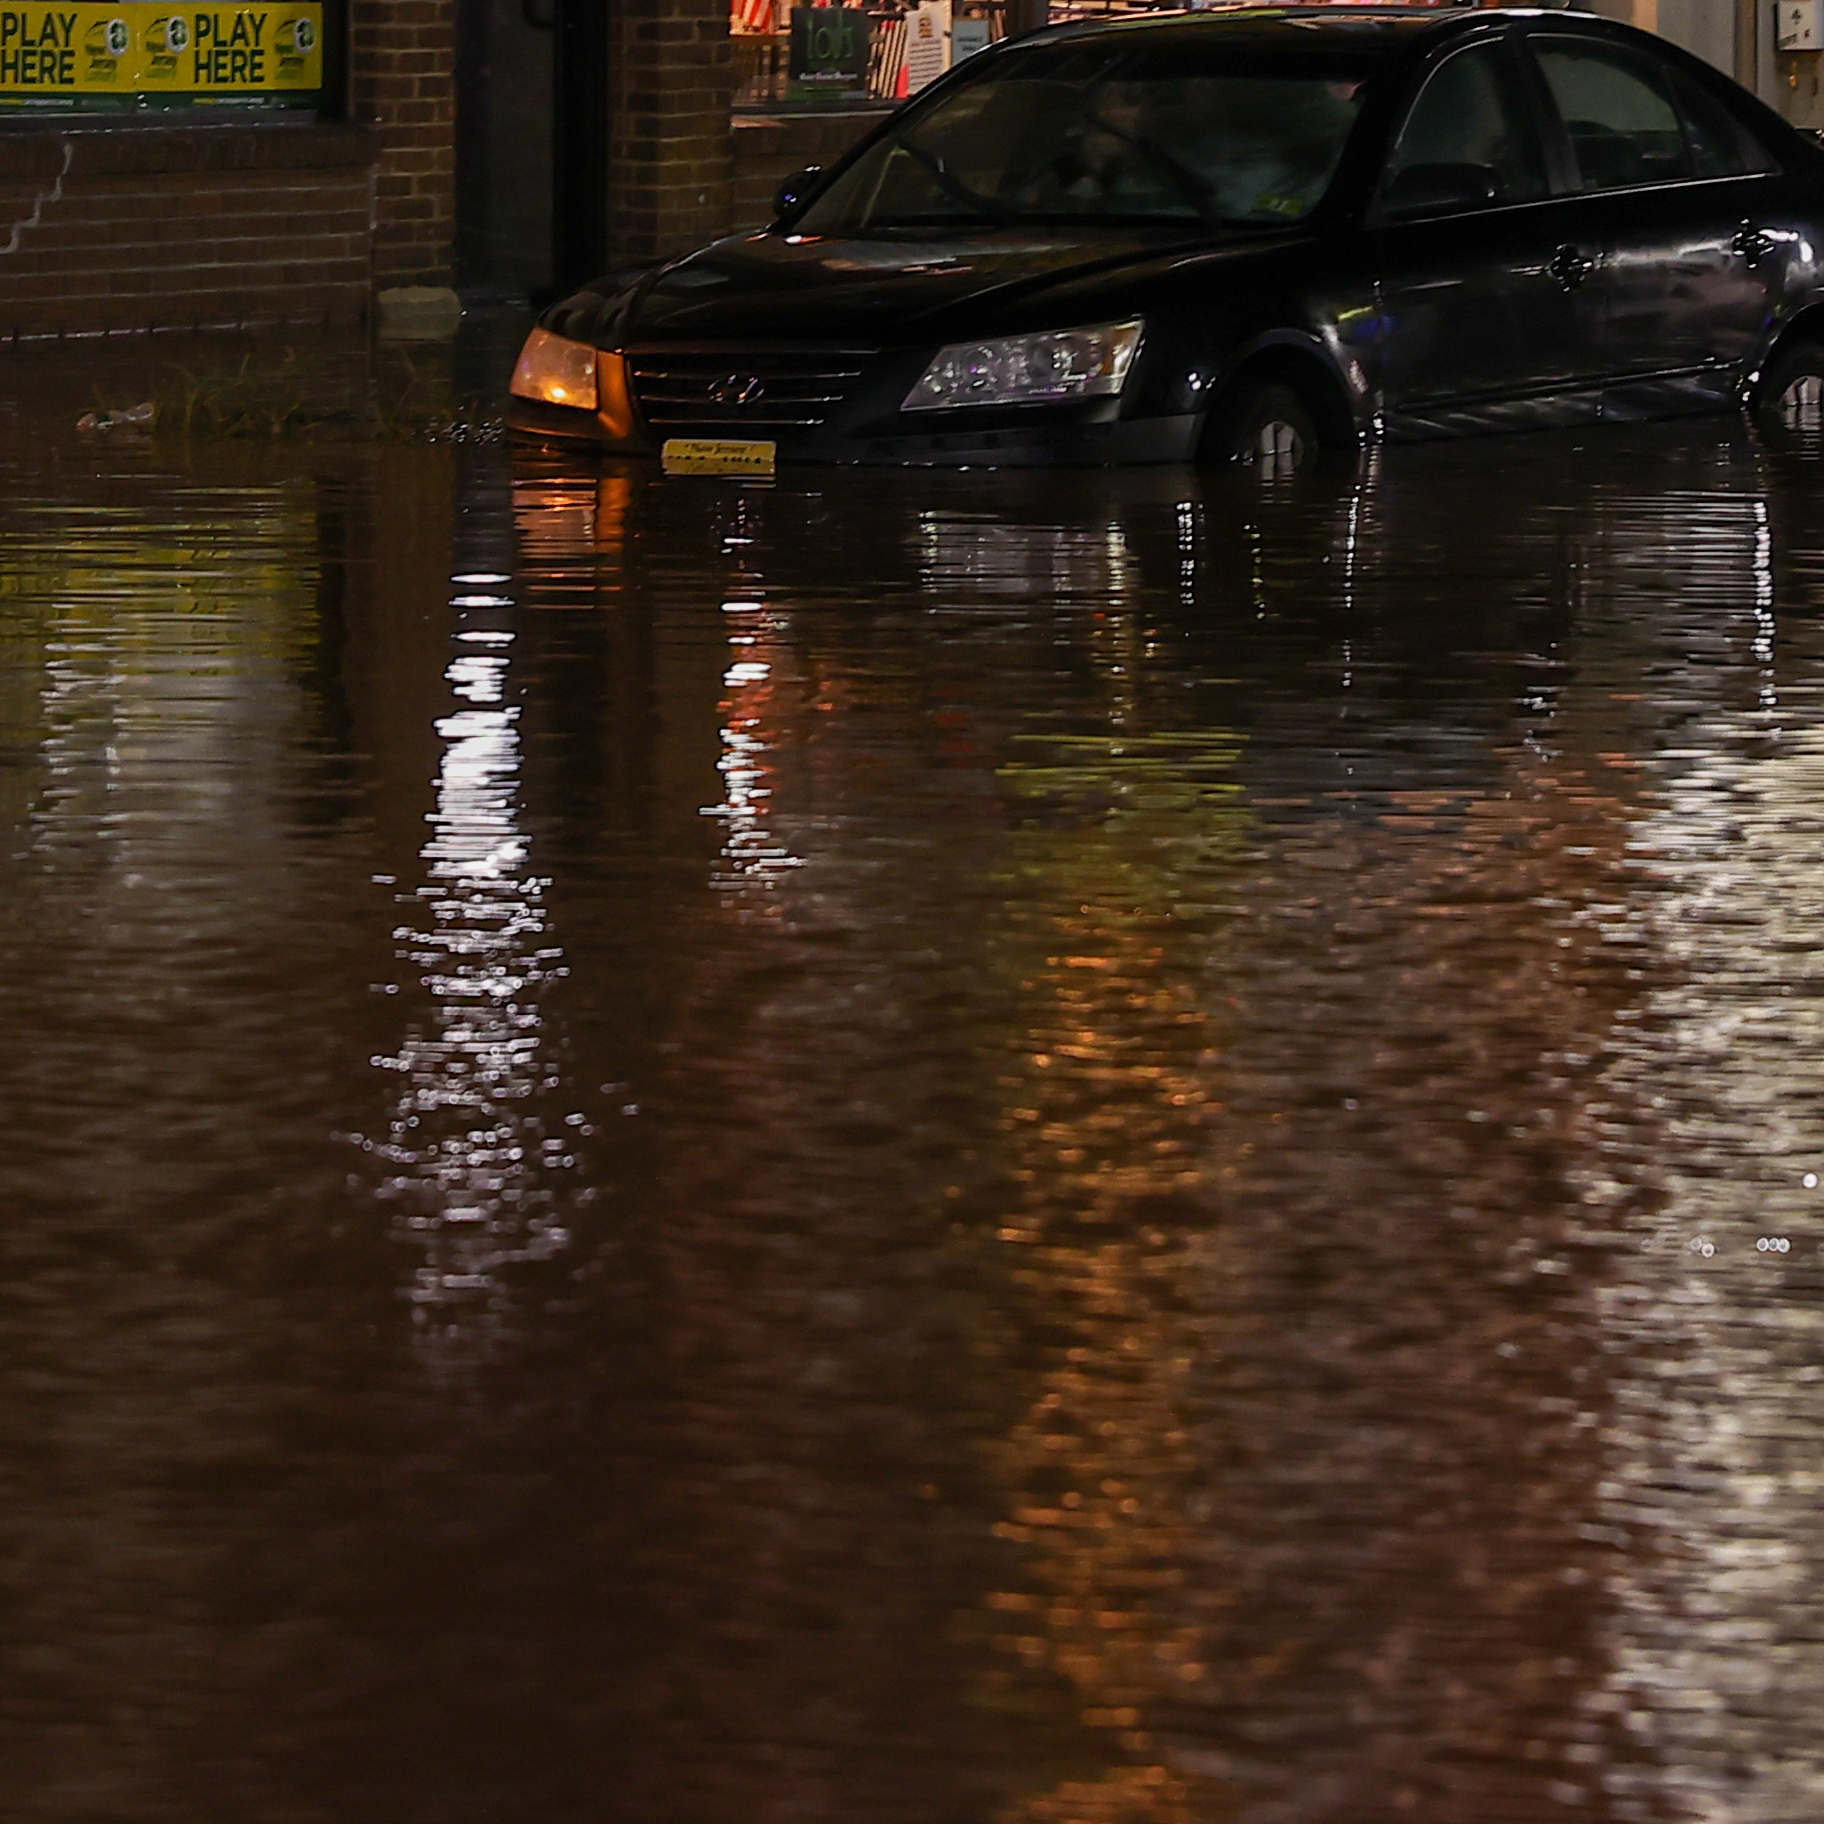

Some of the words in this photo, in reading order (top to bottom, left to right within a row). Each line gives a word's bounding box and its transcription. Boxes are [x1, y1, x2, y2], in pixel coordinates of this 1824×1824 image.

[0, 12, 78, 48] PLAY
[195, 12, 268, 48] PLAY
[0, 49, 76, 85] HERE
[194, 49, 265, 84] HERE
